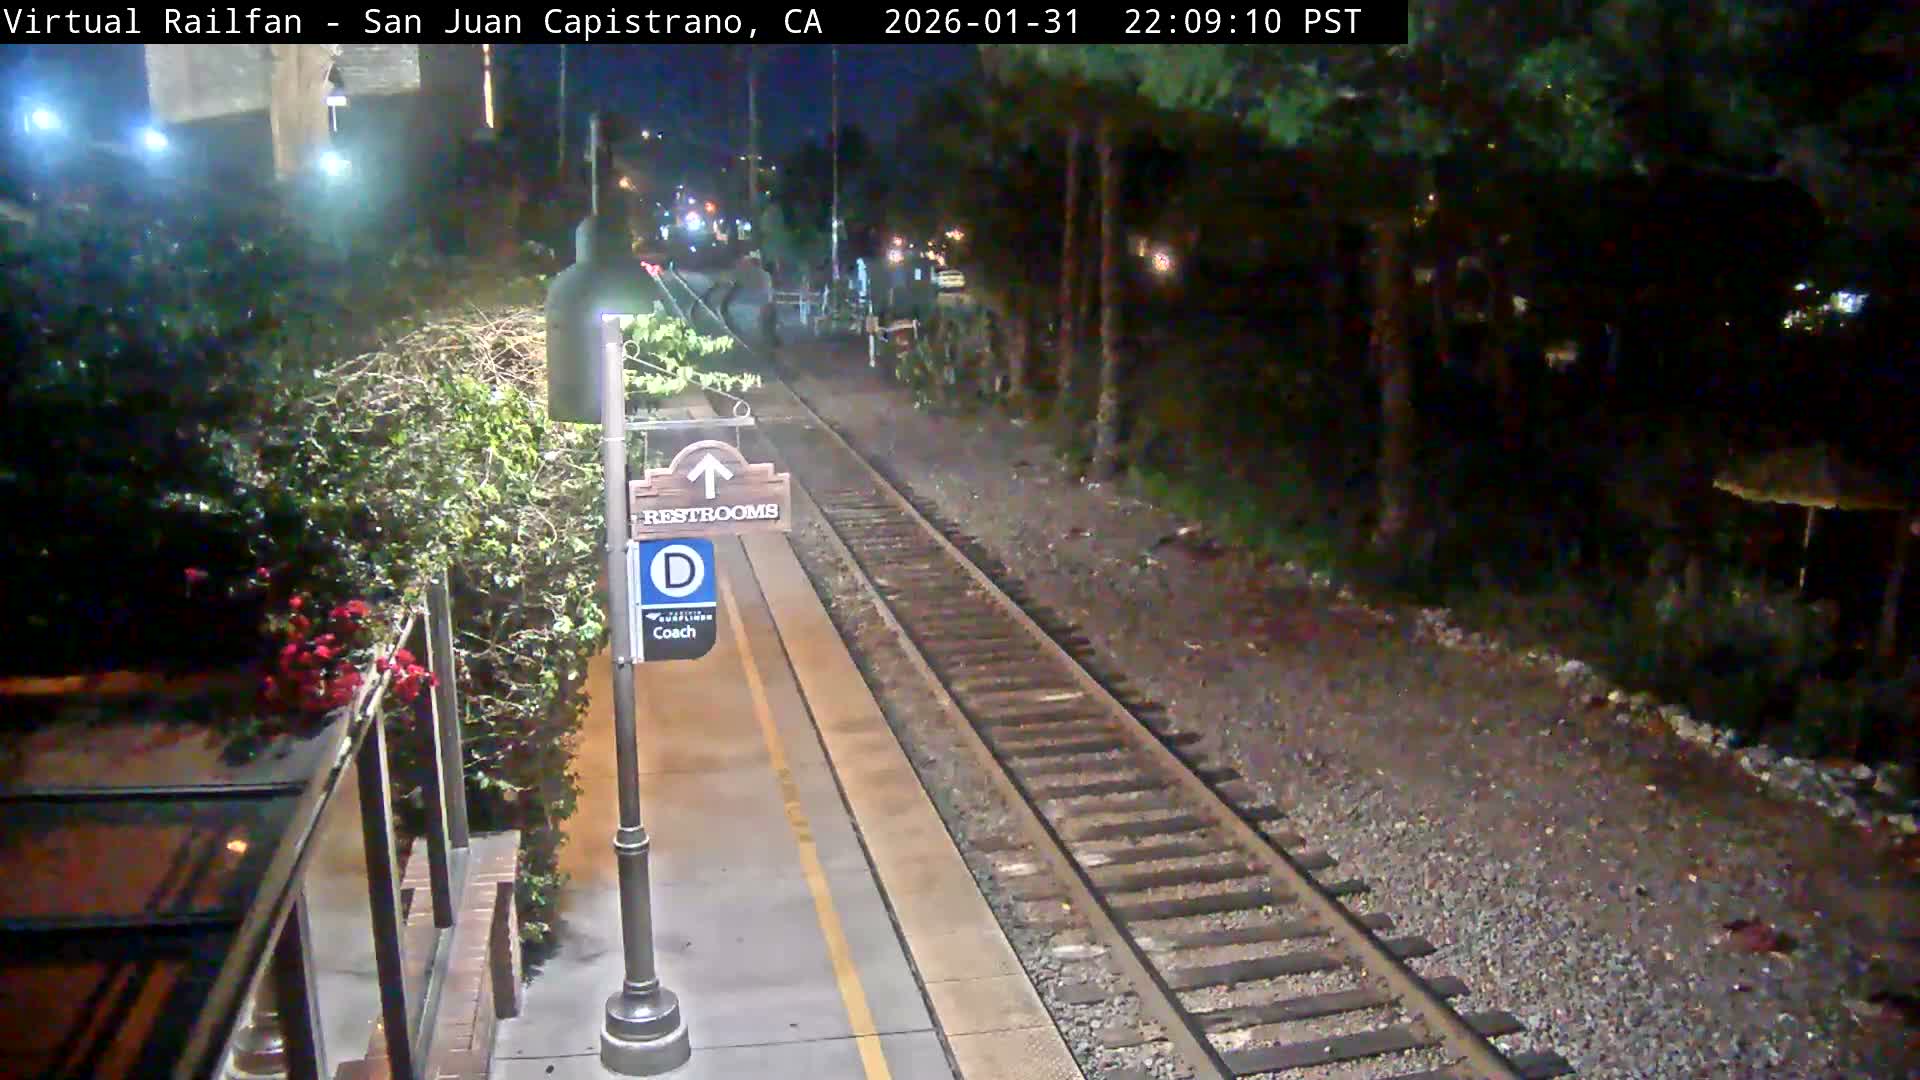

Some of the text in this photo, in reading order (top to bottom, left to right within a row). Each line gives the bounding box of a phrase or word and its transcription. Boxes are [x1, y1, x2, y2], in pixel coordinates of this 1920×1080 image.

[643, 503, 779, 525] RESTROOMS
[664, 552, 696, 589] D
[653, 624, 696, 640] Coach
